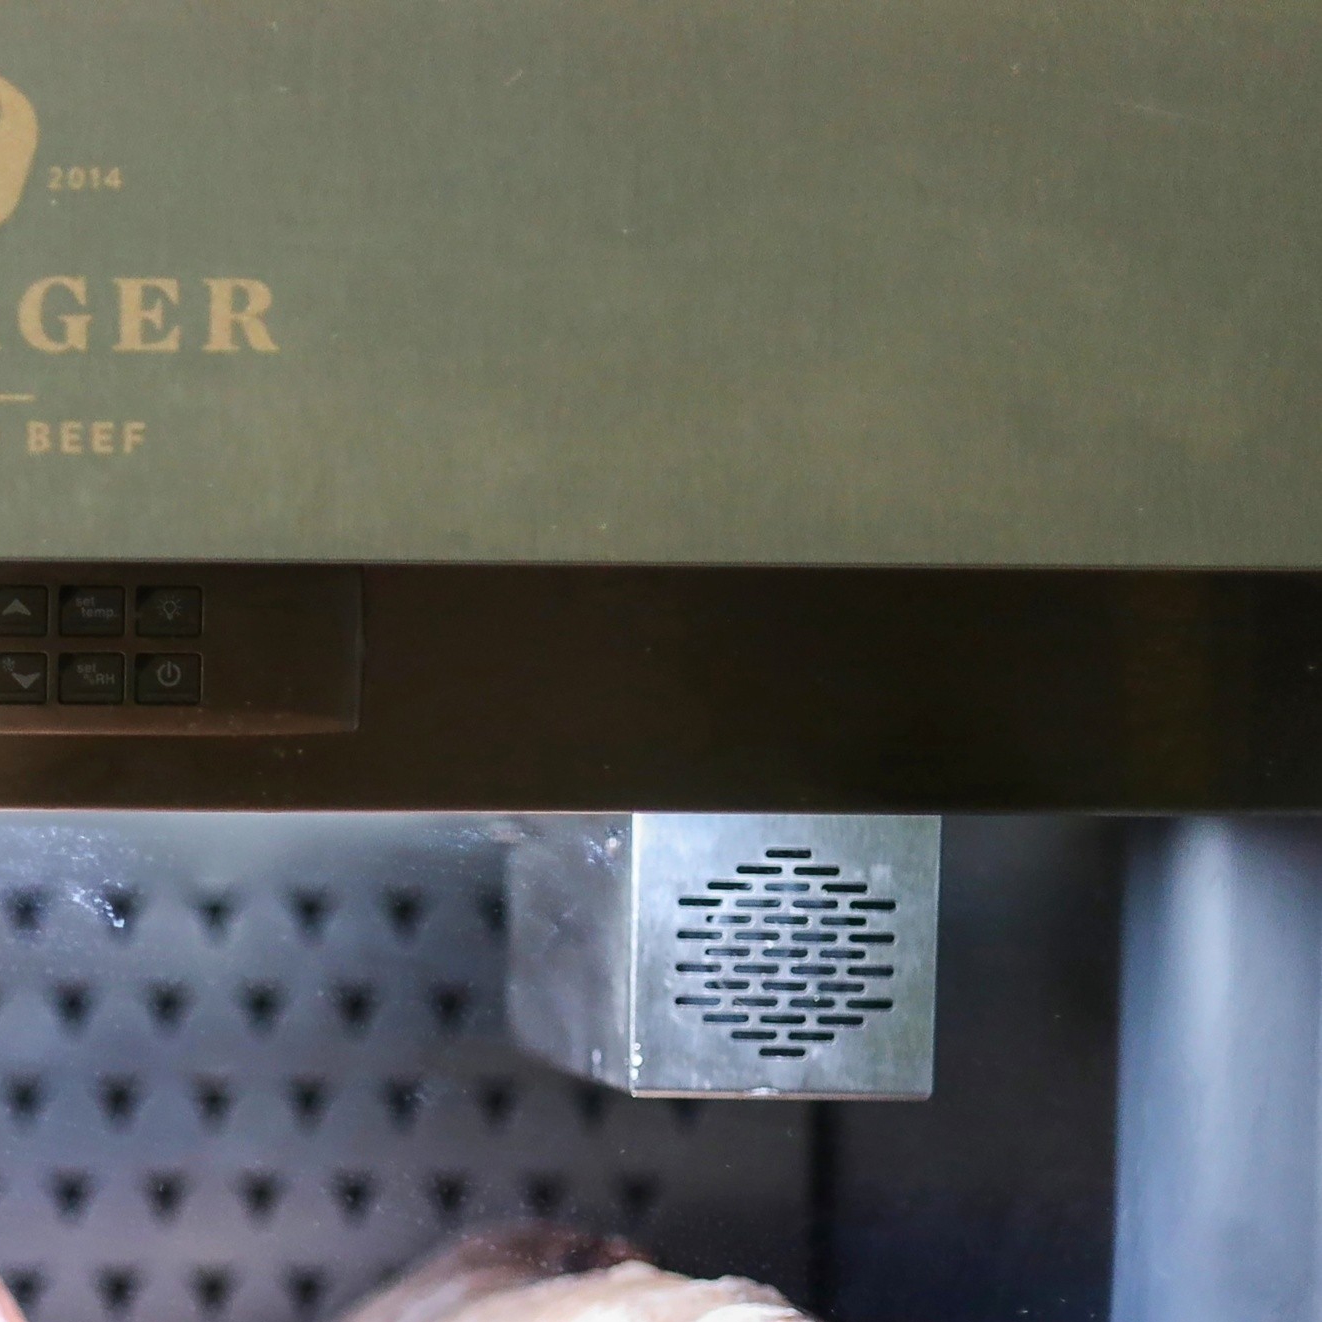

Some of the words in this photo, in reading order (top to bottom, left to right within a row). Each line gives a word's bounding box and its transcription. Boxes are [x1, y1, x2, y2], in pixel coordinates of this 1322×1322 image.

[46, 165, 123, 191] 2014
[25, 421, 148, 454] BEEF
[75, 596, 96, 607] set
[76, 662, 97, 673] set
